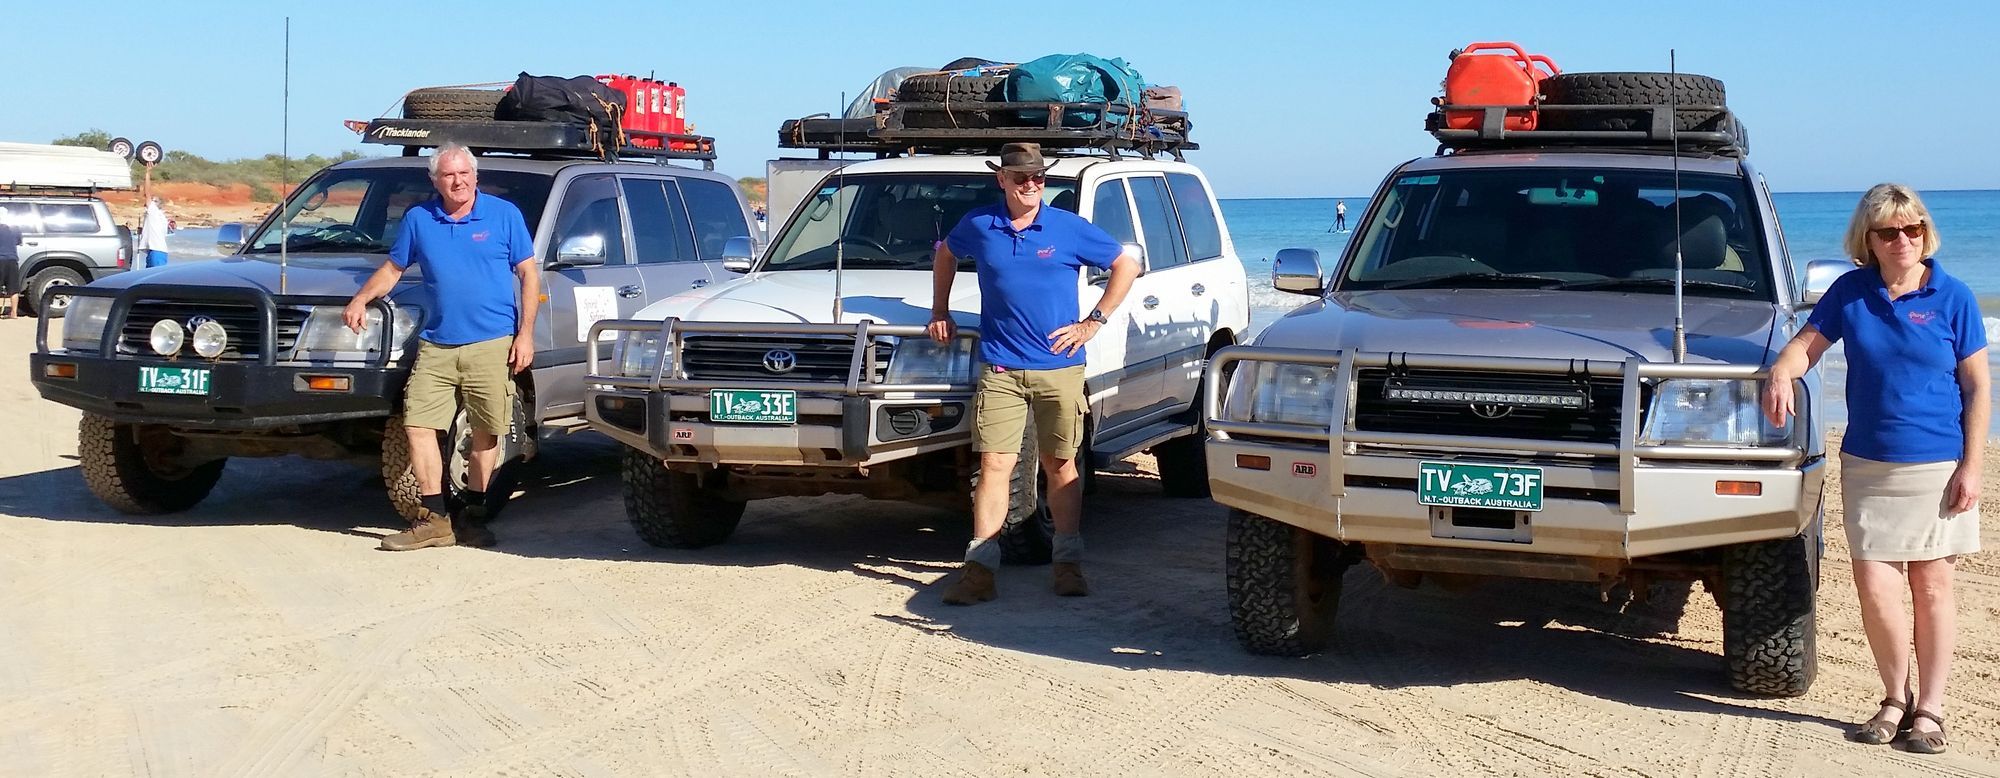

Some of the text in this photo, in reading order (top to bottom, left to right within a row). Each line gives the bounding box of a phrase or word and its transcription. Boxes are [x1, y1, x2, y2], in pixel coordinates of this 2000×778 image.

[384, 126, 430, 138] Tracklander
[140, 367, 210, 389] TV 31F
[713, 392, 793, 415] TV 33E
[1295, 464, 1313, 474] ARB
[1421, 468, 1540, 496] TV 73F
